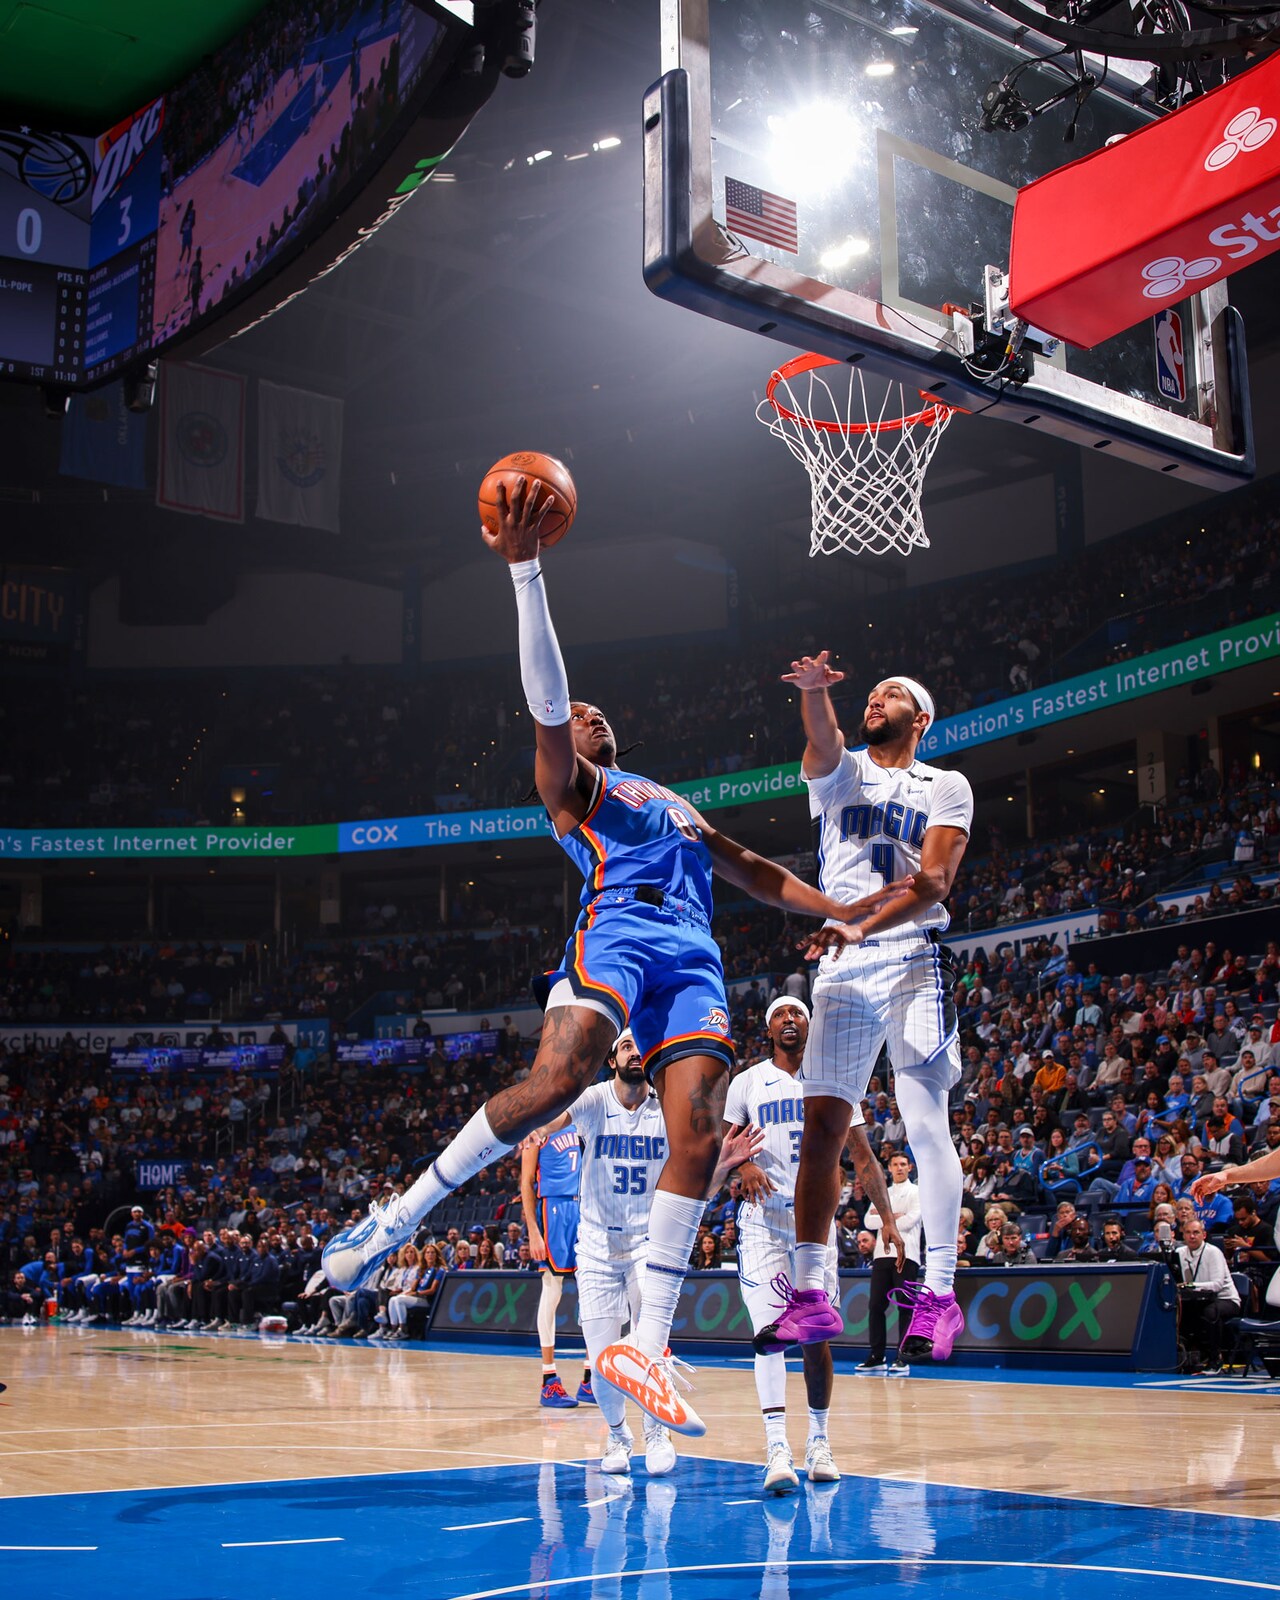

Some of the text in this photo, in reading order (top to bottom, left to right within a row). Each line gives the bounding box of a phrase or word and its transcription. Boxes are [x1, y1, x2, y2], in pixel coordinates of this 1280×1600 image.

[91, 97, 163, 216] OKC
[17, 208, 42, 255] 0
[118, 195, 132, 246] 3
[0, 278, 32, 293] LL-POPE
[57, 272, 85, 285] PTS FL
[62, 289, 82, 300] 0 0
[61, 305, 81, 317] 0 0
[60, 321, 80, 333] 0 0
[59, 338, 79, 349] 0 0
[8, 363, 14, 373] 0
[31, 366, 45, 377] 1ST
[55, 371, 77, 382] 11:10
[58, 354, 79, 366] 0 0
[1161, 375, 1176, 394] NBA
[118, 386, 128, 445] OKLAH
[2, 581, 64, 633] CITY
[9, 645, 48, 658] NOW
[945, 707, 1024, 745] Nation's
[1032, 679, 1108, 719] Fastest
[1117, 648, 1210, 693] Internet
[1220, 621, 1280, 662] Provi
[719, 771, 802, 800] Provider
[1147, 751, 1155, 795] 221
[352, 825, 398, 845] COX
[425, 812, 551, 838] The Nation's
[667, 806, 700, 842] 8
[839, 801, 929, 850] MAGIC
[31, 836, 105, 852] Fastest
[114, 833, 197, 852] Internet
[206, 832, 295, 850] Provider
[871, 843, 895, 889] 4
[1064, 926, 1095, 945] 114
[0, 1032, 115, 1051] cthuder
[299, 1030, 326, 1047] 112
[594, 1134, 665, 1160] MAGIC
[789, 1130, 803, 1163] 3
[568, 1150, 578, 1172] 7
[613, 1165, 647, 1195] 35
[449, 1281, 527, 1325] COX
[968, 1281, 1112, 1340] COX
